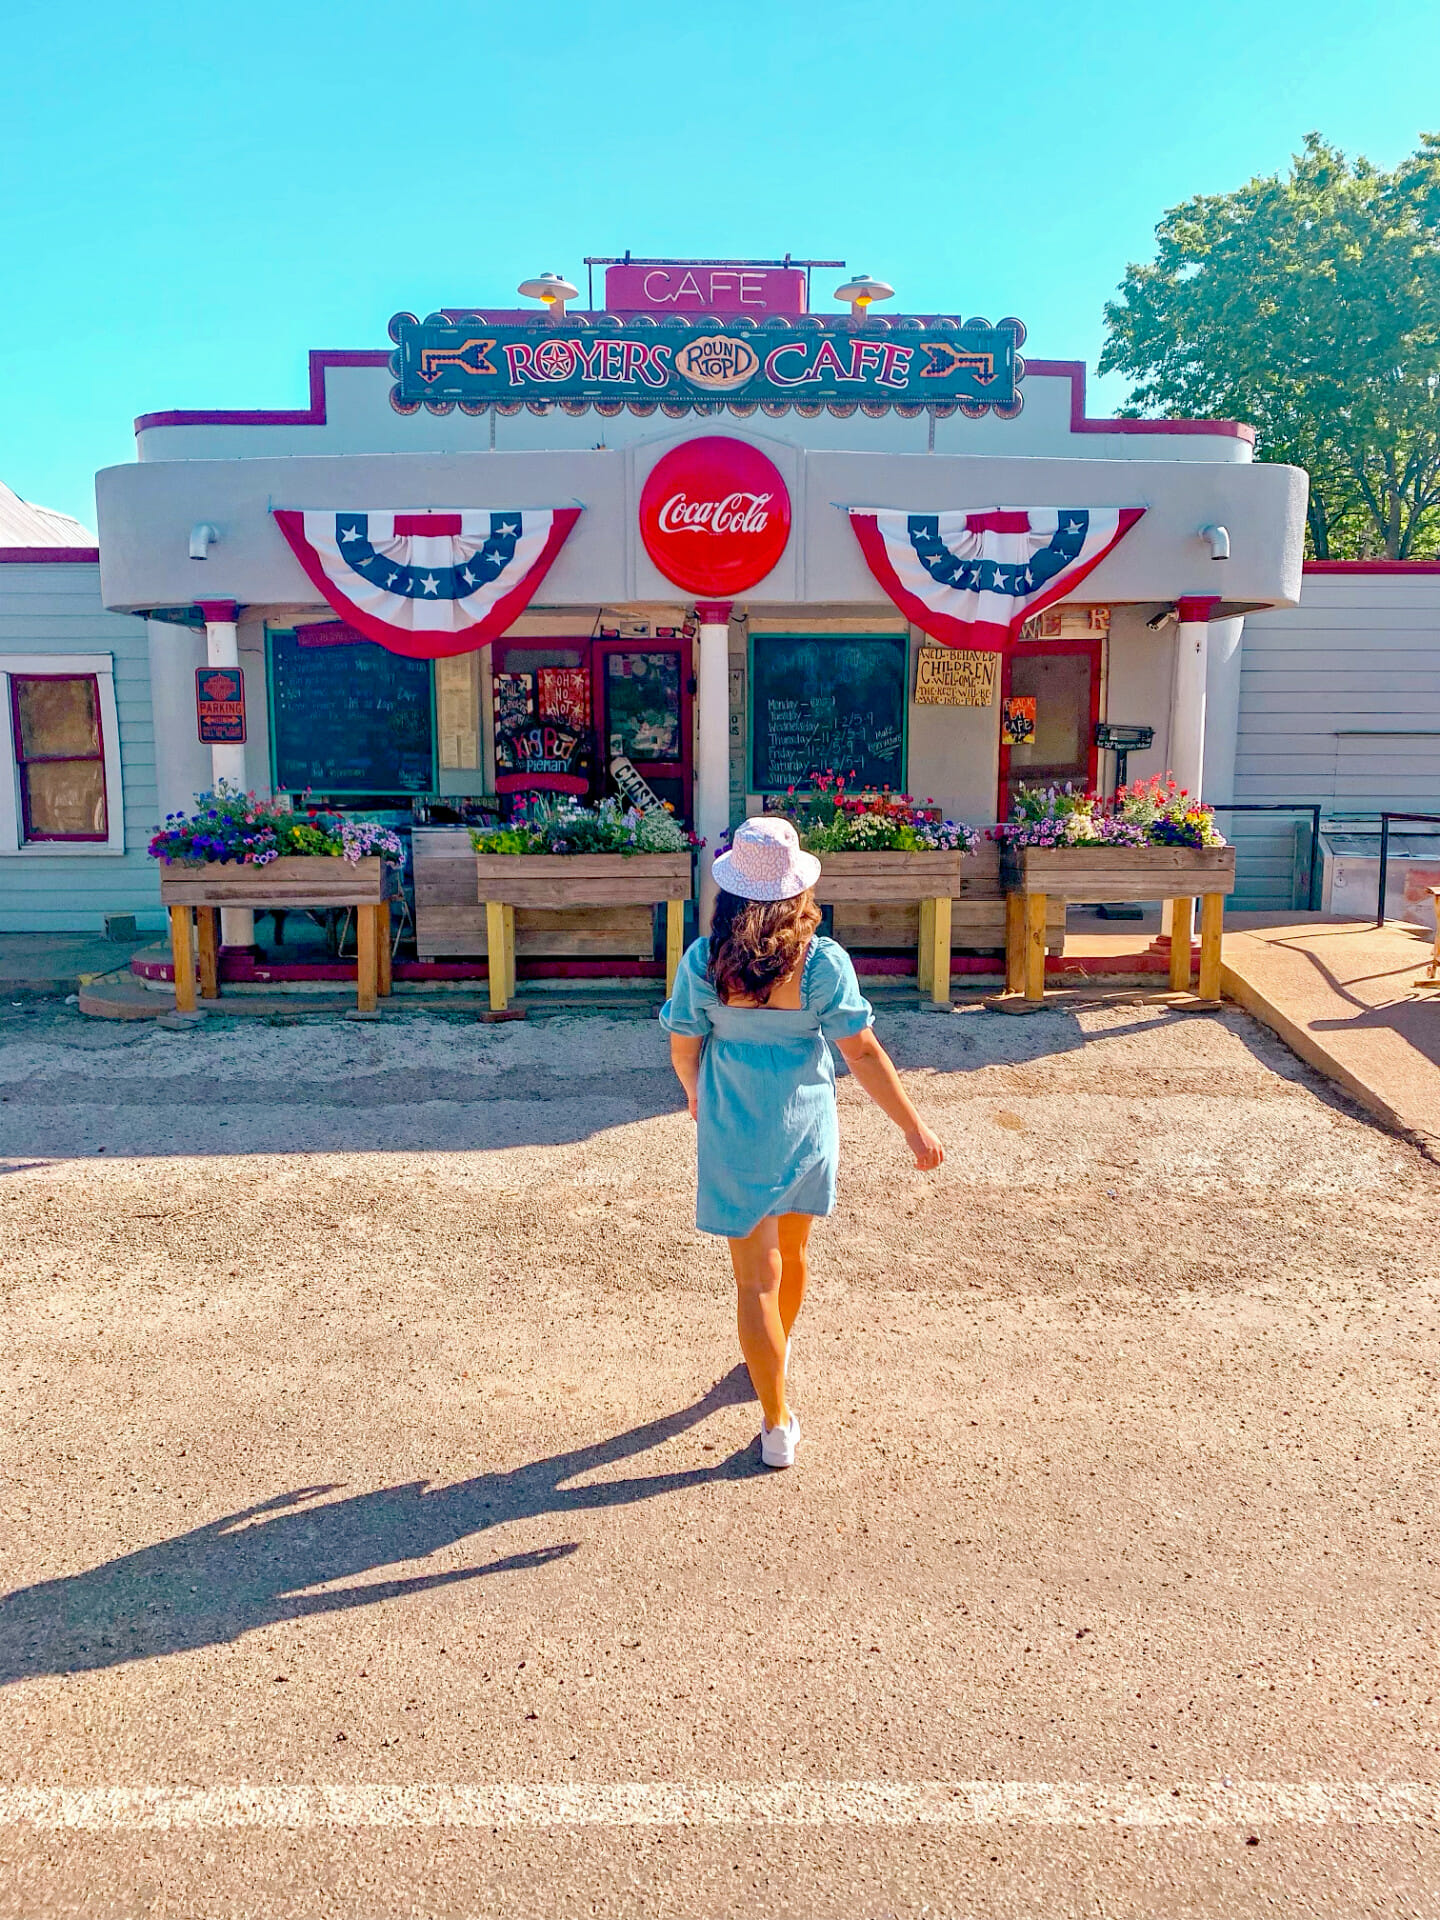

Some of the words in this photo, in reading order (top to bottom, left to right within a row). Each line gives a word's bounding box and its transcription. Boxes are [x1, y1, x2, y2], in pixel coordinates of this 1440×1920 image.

[644, 271, 767, 308] CAFE
[503, 339, 672, 388] ROYERS
[765, 340, 914, 388] CAFE
[687, 341, 752, 377] ROUND
[701, 357, 734, 378] TOP
[658, 492, 774, 533] Coca-Cola
[556, 673, 569, 687] OH
[921, 661, 995, 686] CHILDREN
[933, 672, 976, 688] WELCOME
[555, 687, 569, 701] NO
[199, 702, 242, 714] PARKING
[1004, 719, 1031, 732] CAFE
[768, 772, 802, 786] Sunday
